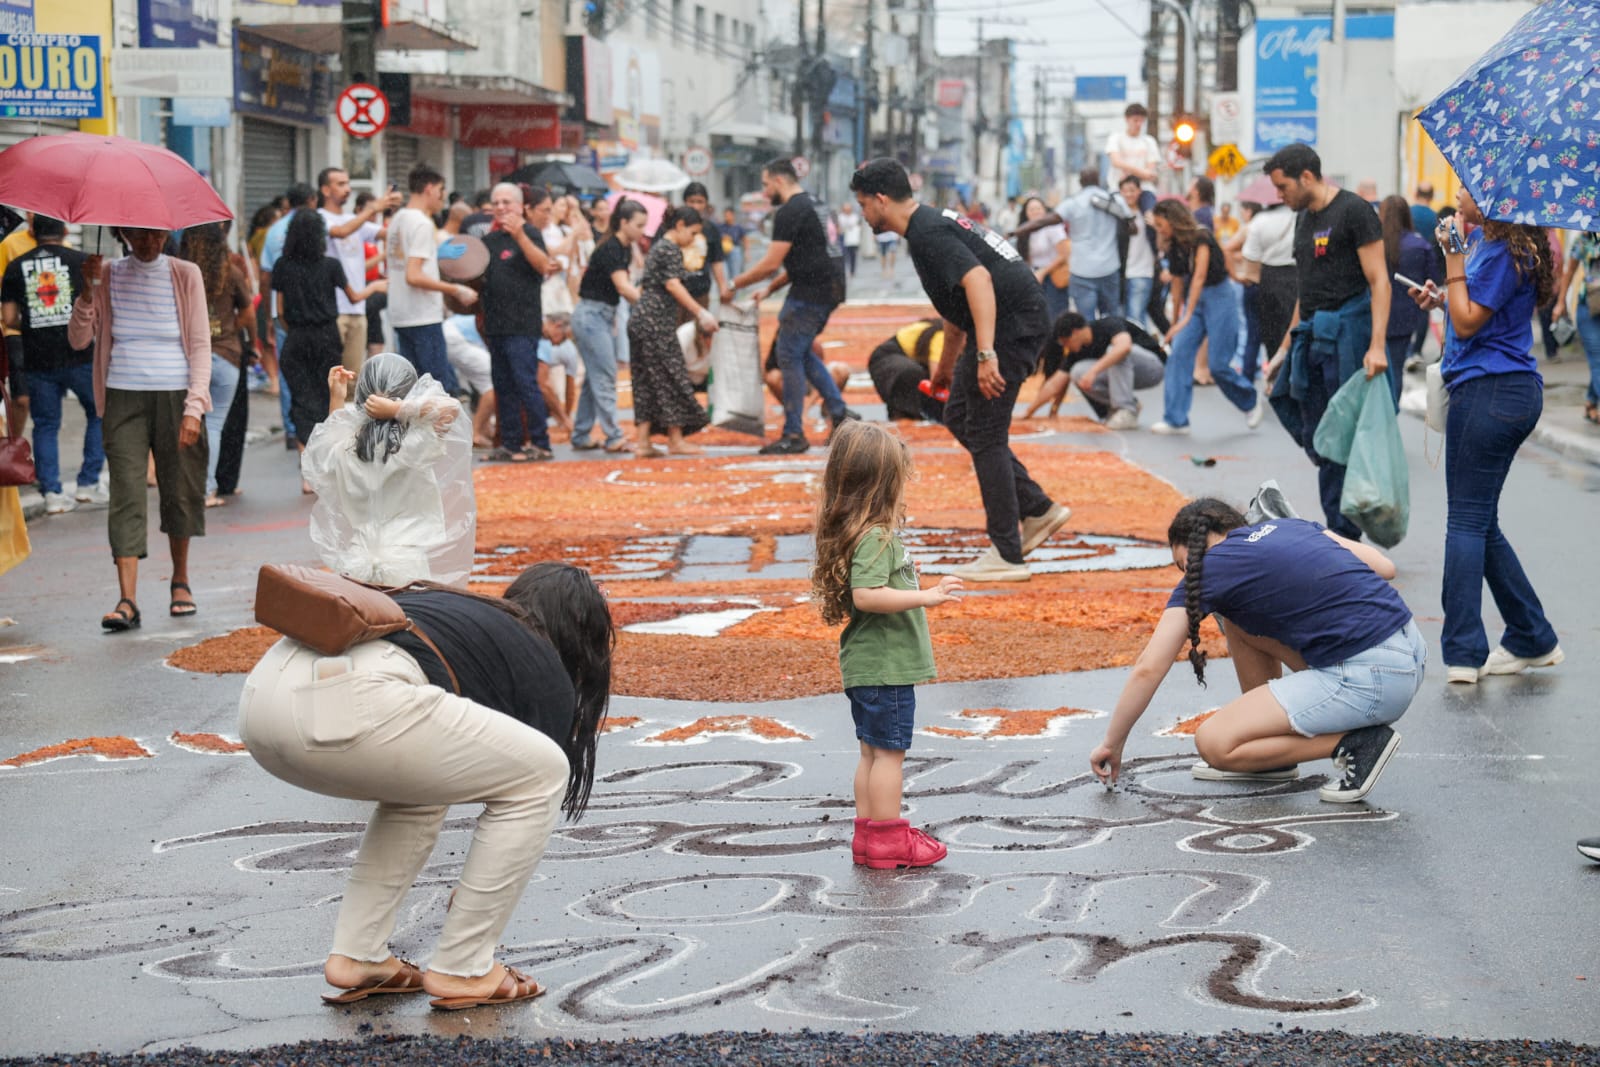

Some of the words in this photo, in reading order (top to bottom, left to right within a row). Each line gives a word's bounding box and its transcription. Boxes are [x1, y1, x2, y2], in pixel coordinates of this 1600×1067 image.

[7, 34, 81, 47] COMPRO
[0, 46, 97, 90] OURO
[35, 90, 53, 99] EM
[55, 90, 95, 100] GERAL
[21, 256, 69, 277] FIEL
